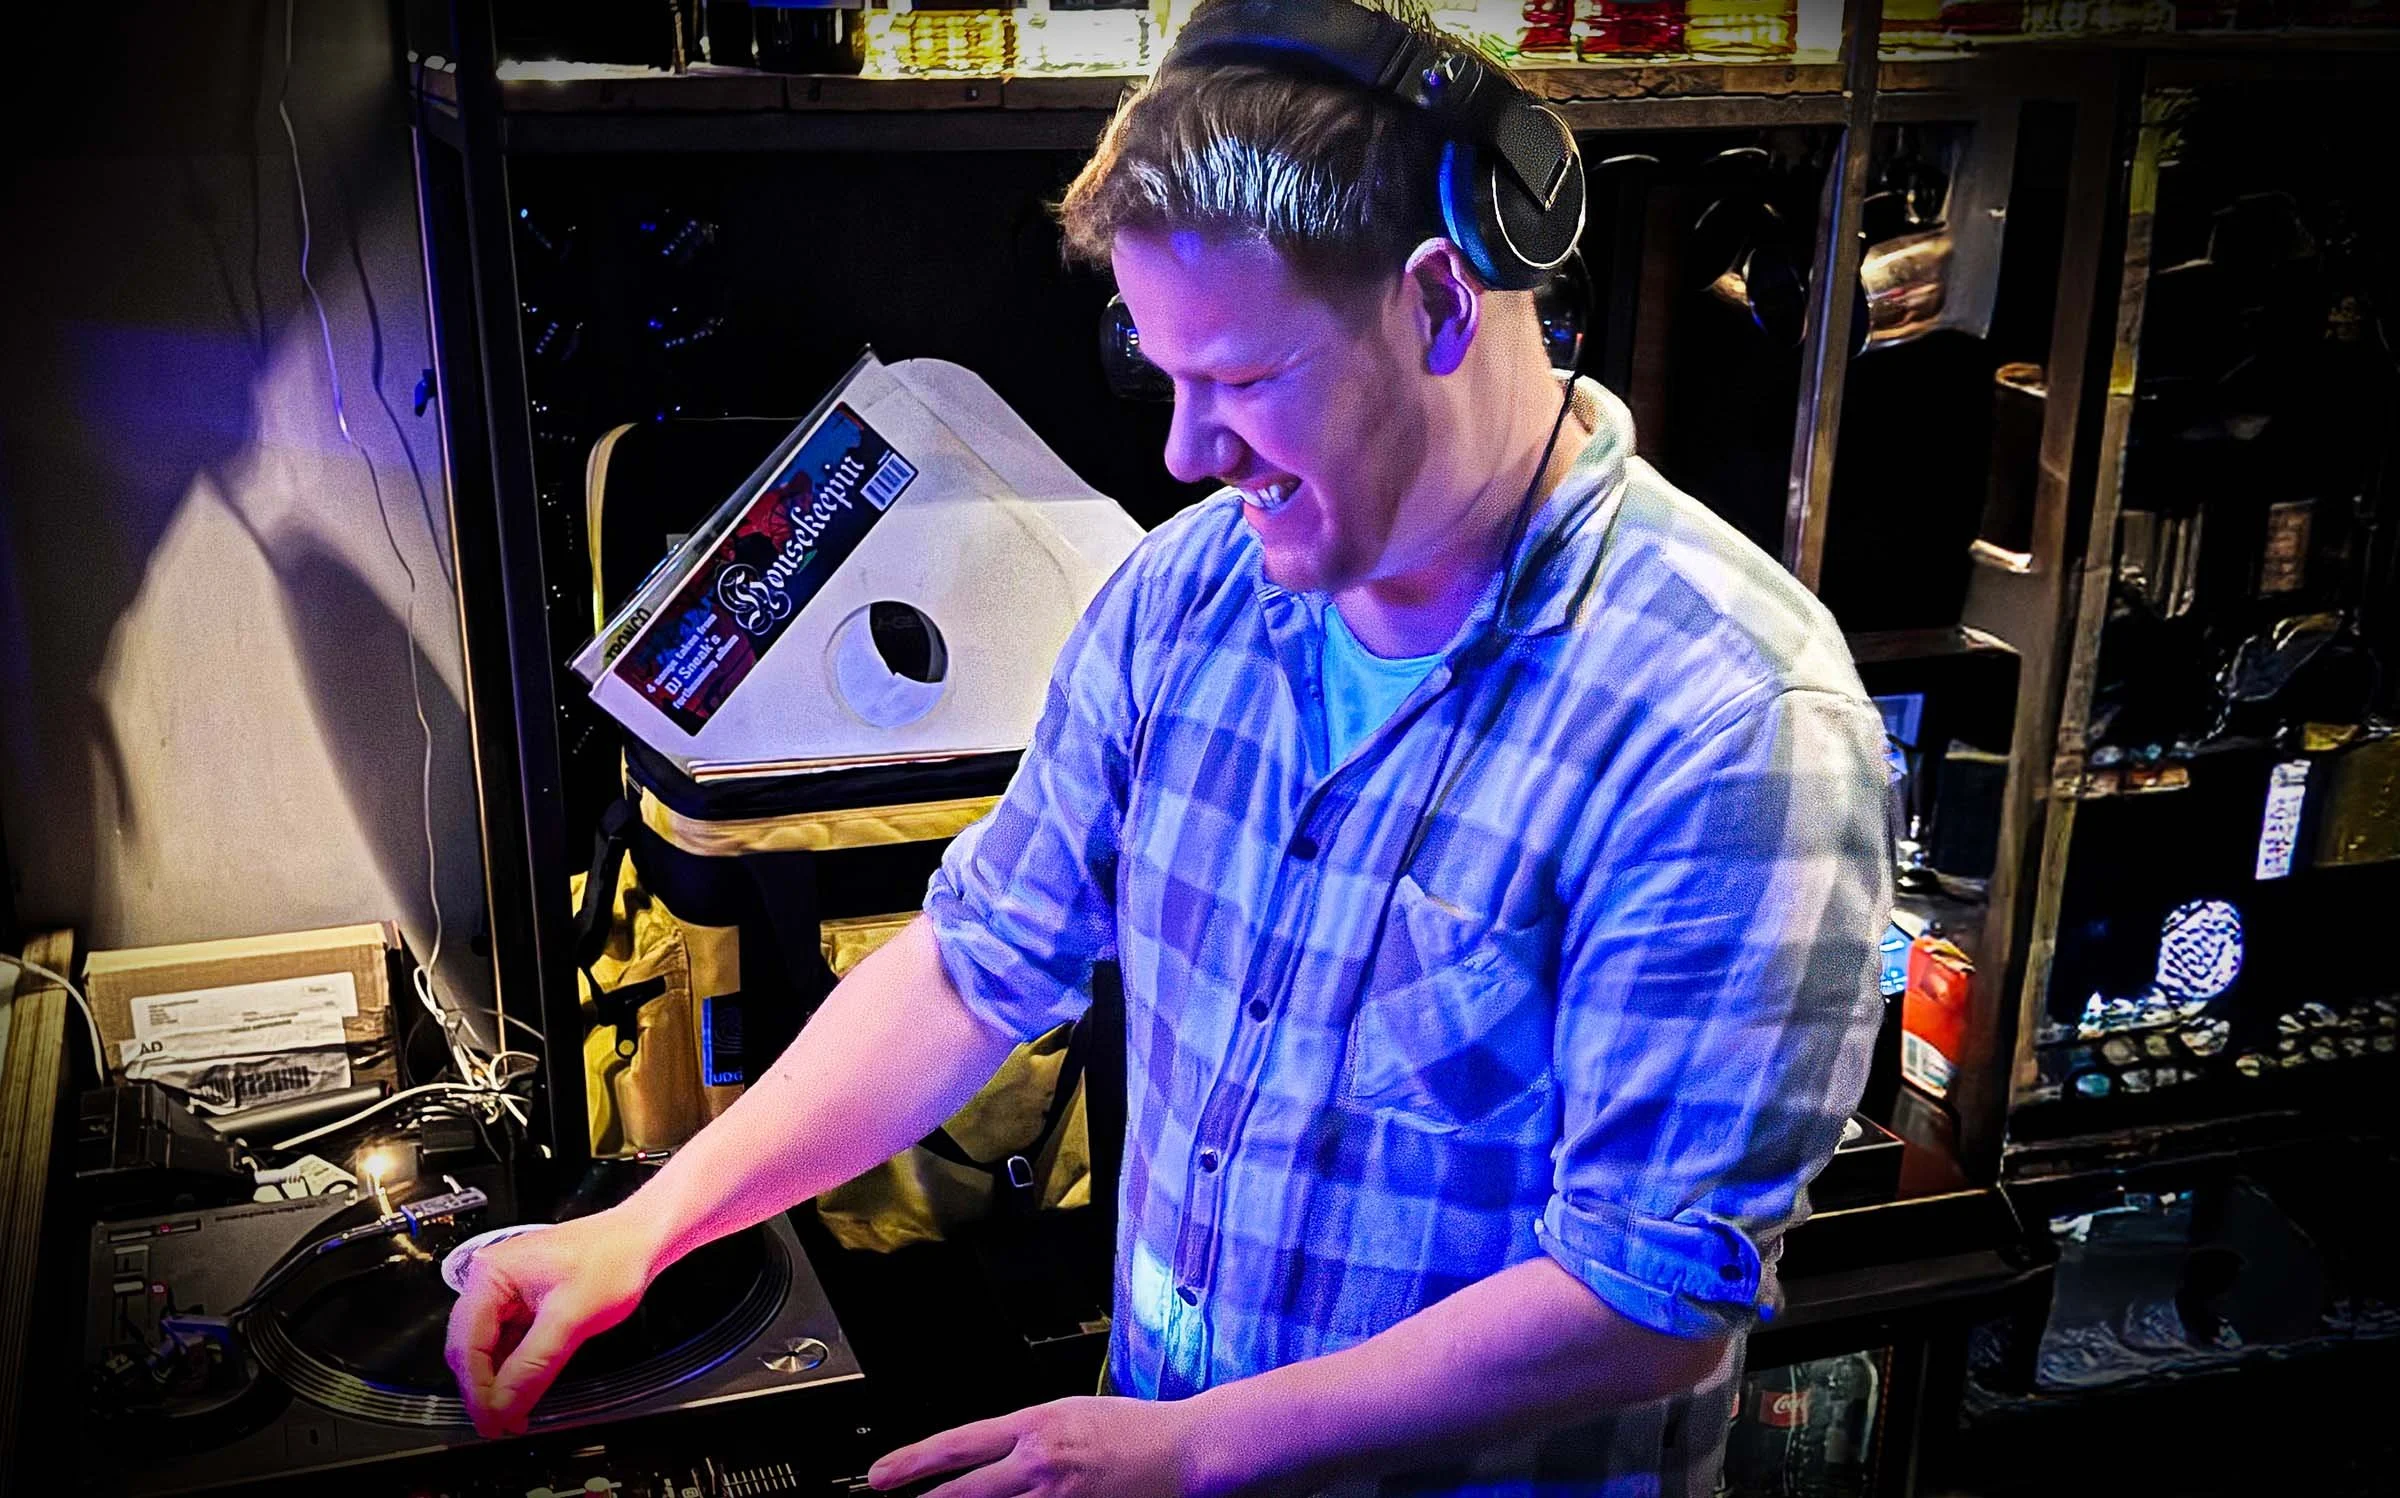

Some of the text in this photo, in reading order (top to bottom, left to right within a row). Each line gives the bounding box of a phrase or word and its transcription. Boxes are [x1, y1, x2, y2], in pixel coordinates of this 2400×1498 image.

[717, 455, 865, 636] Housekeepin
[664, 634, 721, 695] DJ Sneak's
